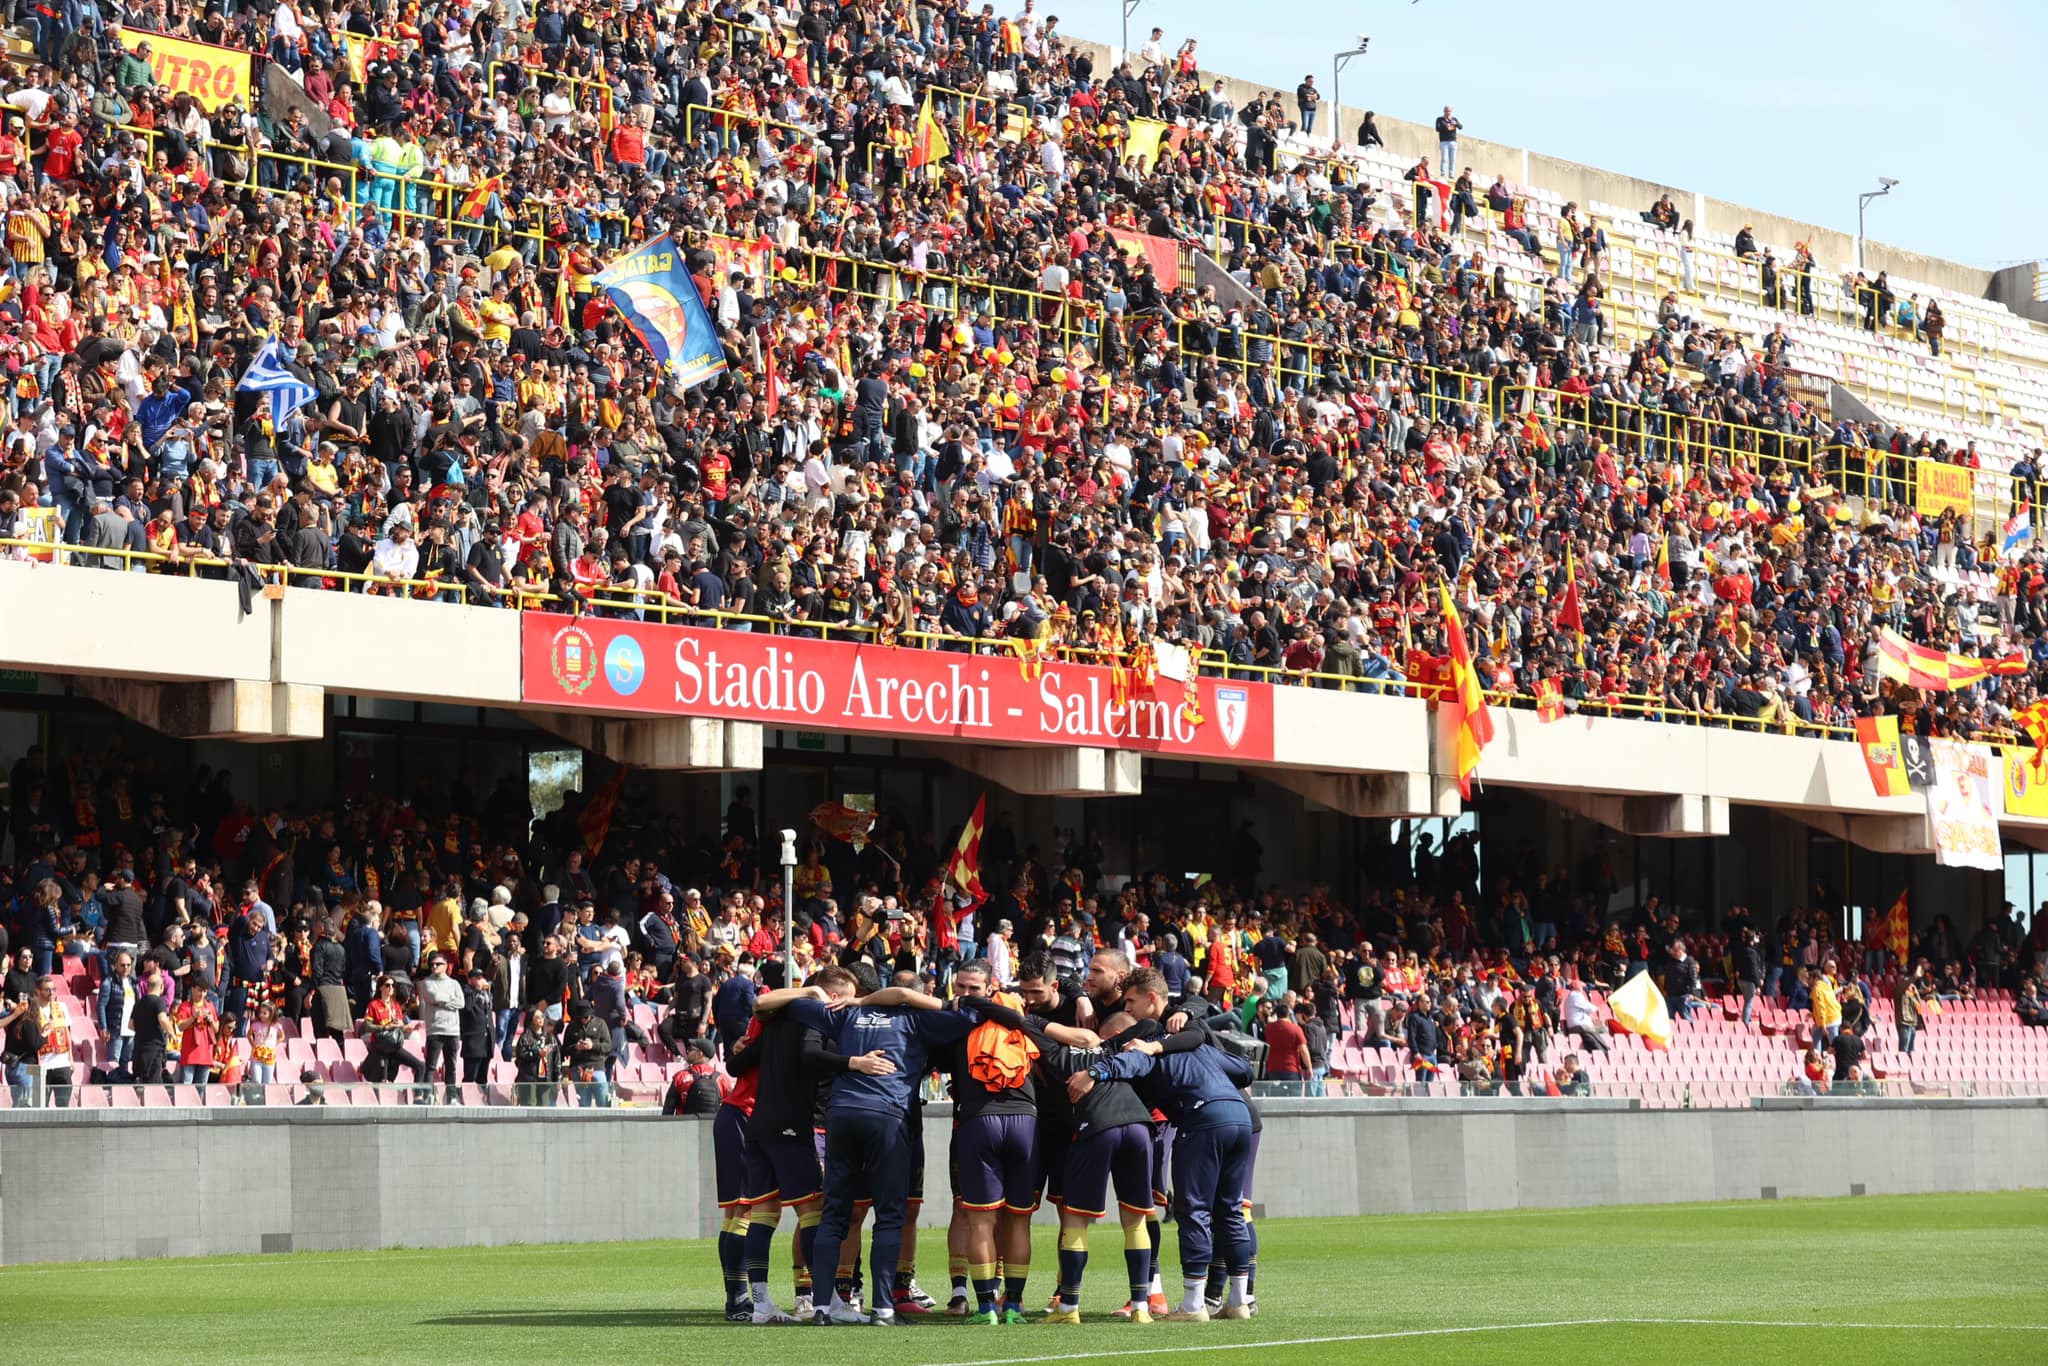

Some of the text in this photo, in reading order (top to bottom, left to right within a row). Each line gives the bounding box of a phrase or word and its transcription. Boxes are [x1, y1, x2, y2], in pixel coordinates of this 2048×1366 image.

[129, 48, 235, 99] UTRO
[675, 637, 825, 714] Stadio
[841, 655, 993, 727] Arechi
[1007, 708, 1023, 717] -
[1040, 671, 1196, 744] Salerno
